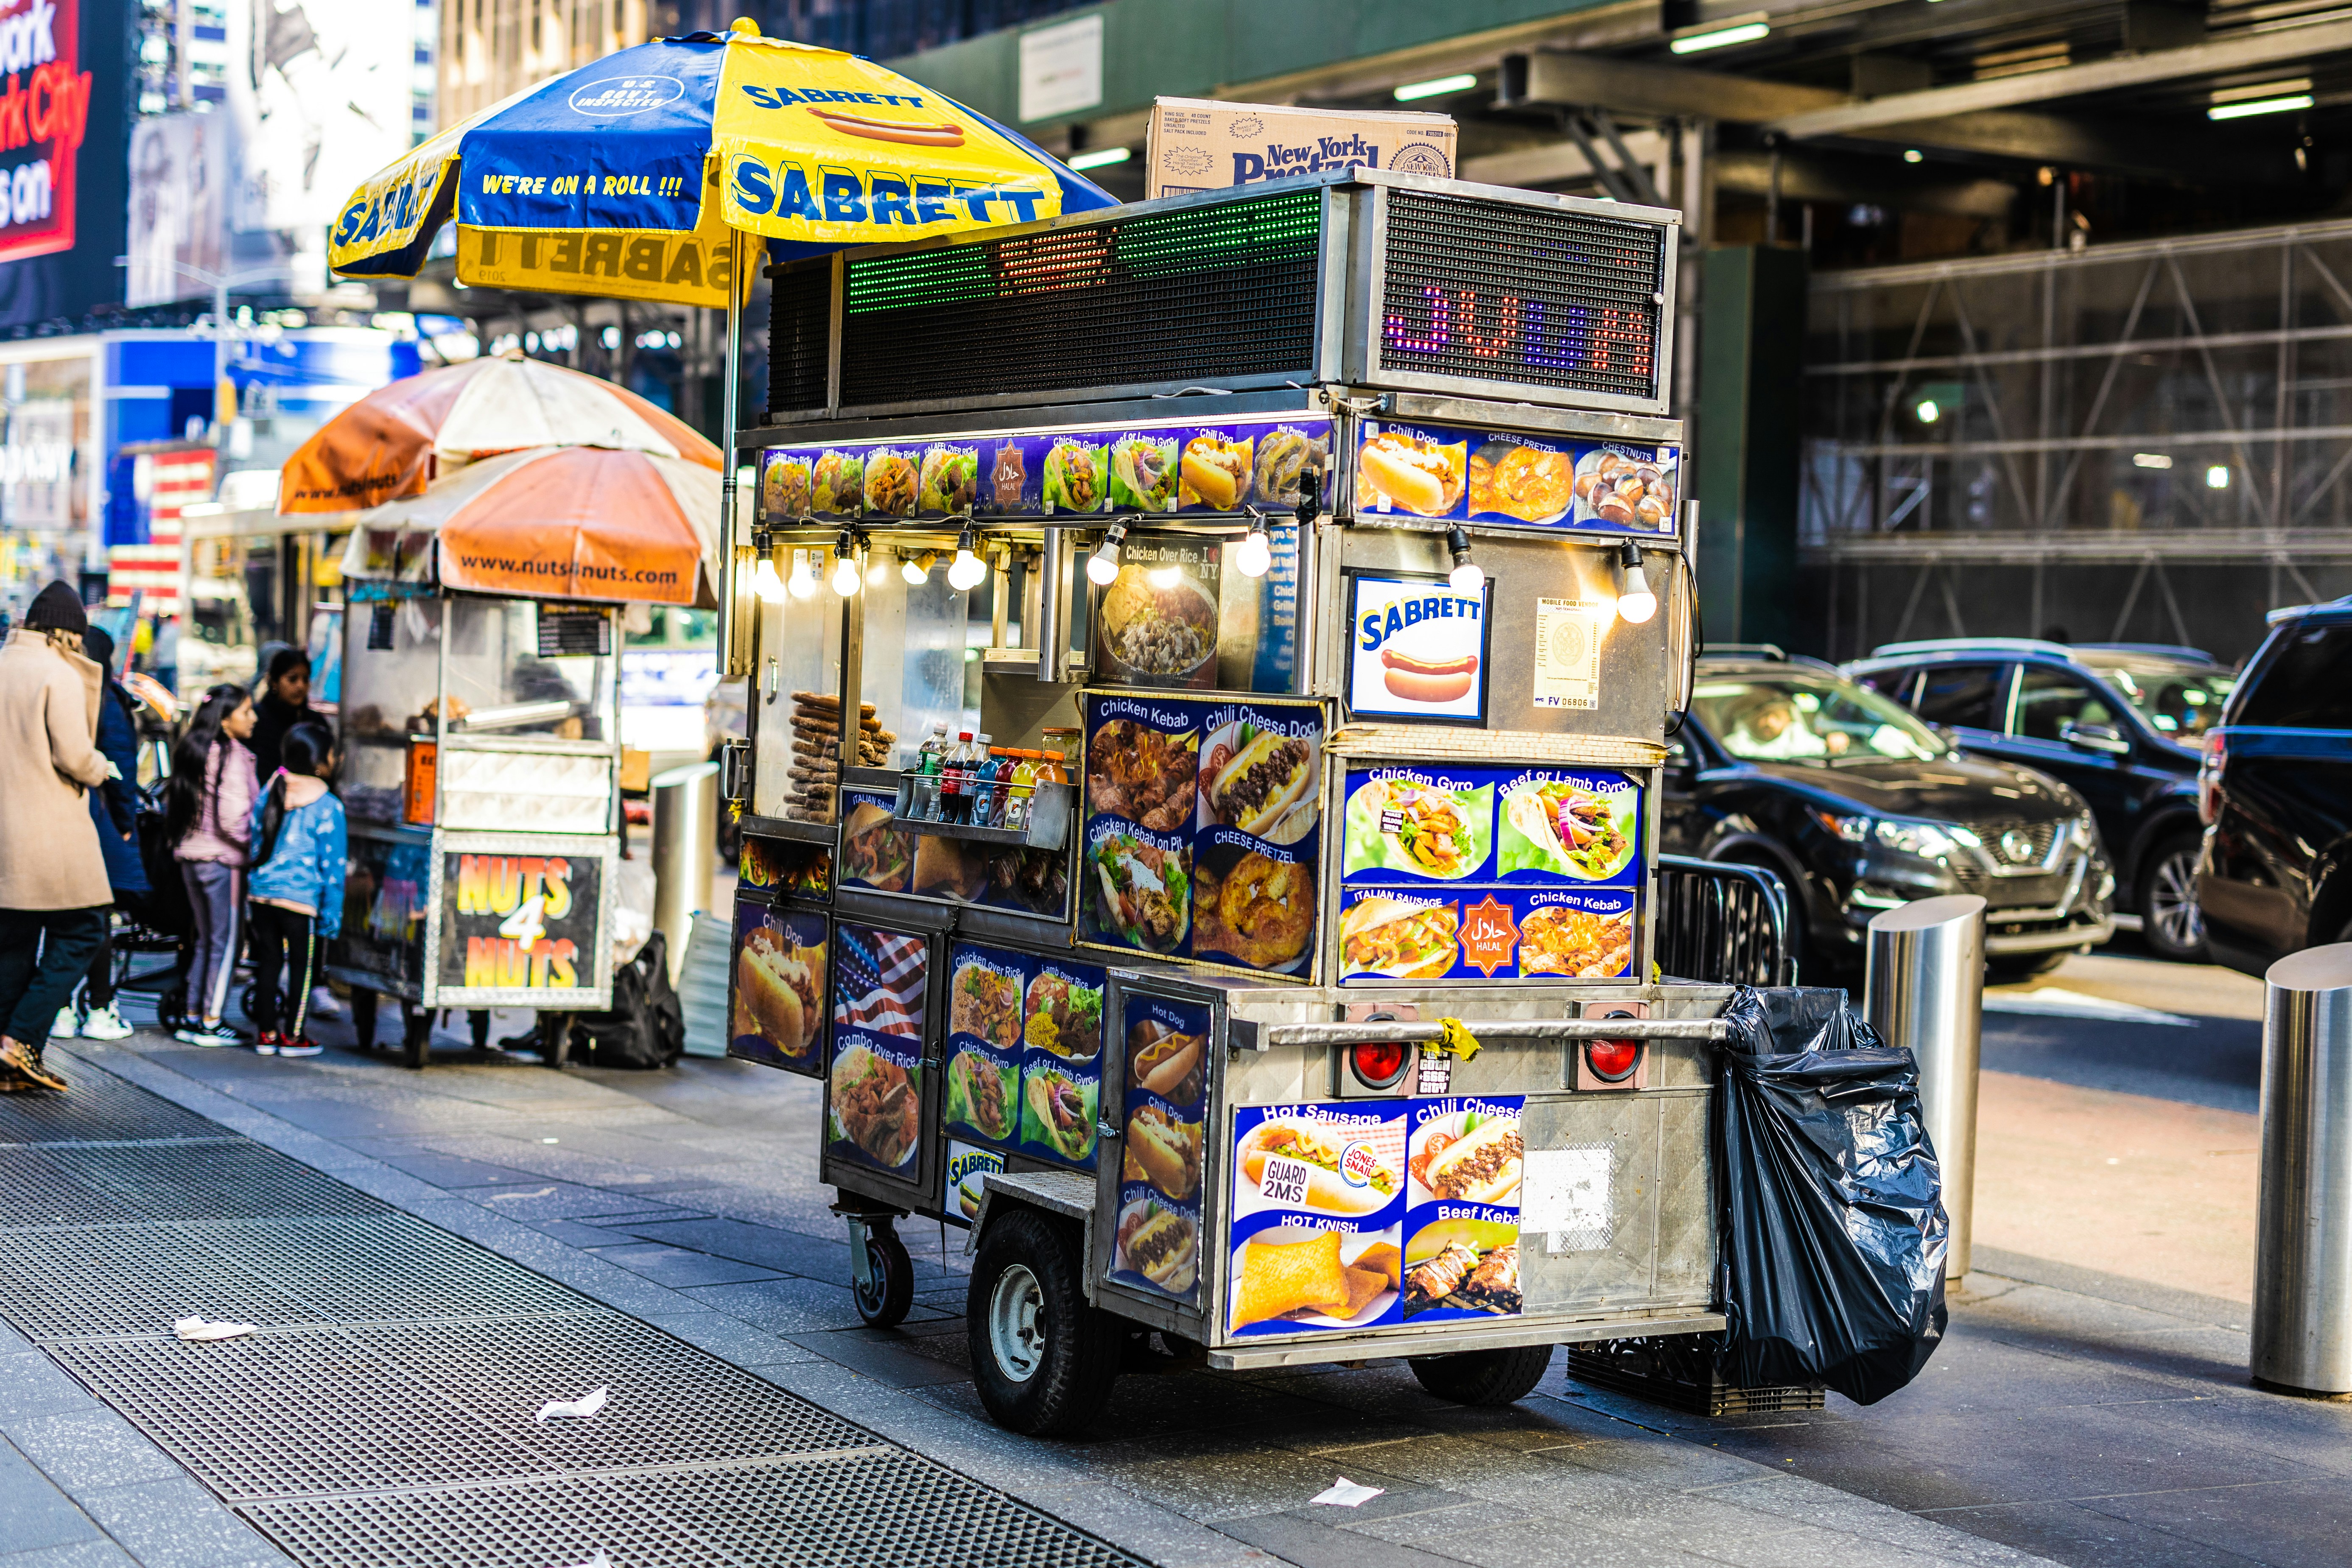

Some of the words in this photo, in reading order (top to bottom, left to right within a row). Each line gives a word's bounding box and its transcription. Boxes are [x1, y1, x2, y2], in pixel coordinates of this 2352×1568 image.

[576, 98, 663, 107] INSPECTED
[600, 89, 657, 99] GOV'T
[741, 84, 923, 109] SABRETT
[28, 61, 92, 188] City
[1266, 144, 1312, 167] New
[1317, 133, 1368, 160] York
[1422, 163, 1437, 172] YORK
[482, 174, 547, 195] WE'RE
[551, 175, 578, 196] ON
[584, 175, 596, 195] A
[603, 175, 652, 197] ROLL
[658, 176, 683, 198] !!!
[731, 154, 1045, 226] SABRETT
[333, 170, 439, 247] SABR
[1110, 433, 1128, 454] Beef
[1127, 432, 1136, 441] or
[1136, 430, 1157, 447] Lamb
[1157, 436, 1174, 448] Gyro
[1200, 428, 1216, 441] Chili
[1216, 431, 1233, 445] Dog
[1277, 424, 1287, 434] Hot
[1288, 426, 1308, 439] Pretzel
[1388, 423, 1414, 439] Chili
[1415, 428, 1438, 447] Dog
[822, 448, 834, 457] Lamb
[845, 452, 854, 461] Rice
[867, 445, 889, 461] Combo
[889, 450, 903, 458] over
[903, 449, 917, 459] Rice
[924, 442, 945, 456] FALAFEL
[945, 444, 961, 454] OVER
[961, 445, 974, 456] RICE
[1052, 435, 1082, 449] Chicken
[1082, 439, 1100, 453] Gyro
[1488, 432, 1522, 446] CHEESE
[1523, 438, 1558, 455] PRETZEL
[1602, 441, 1652, 462] CHESTNUTS
[766, 452, 787, 467] Chicken
[787, 456, 799, 466] over
[799, 455, 811, 464] Rice
[1001, 482, 1015, 491] HALAL
[1126, 544, 1158, 562] Chicken
[1159, 547, 1178, 562] Over
[1179, 548, 1198, 564] Rice
[1202, 546, 1209, 563] I
[1200, 564, 1219, 580] NY
[1358, 592, 1481, 651] SABRETT
[1549, 696, 1560, 706] FV
[1562, 698, 1588, 706] 06806
[1101, 698, 1148, 718] Chicken
[1151, 705, 1189, 728] Kebab
[1205, 704, 1235, 732] Chili
[1240, 705, 1286, 738] Cheese
[1290, 720, 1315, 739] Dog
[1369, 768, 1433, 788] Chicken
[1437, 776, 1474, 793] Gyro
[1497, 769, 1534, 798] Beef
[1536, 771, 1552, 780] or
[1555, 770, 1593, 792] Lamb
[1596, 780, 1628, 795] Gyro
[853, 794, 876, 806] ITALIAN
[1008, 799, 1023, 819] G
[1089, 817, 1126, 843] Chicken
[1128, 822, 1155, 849] Kebab
[1158, 838, 1169, 851] on
[1171, 835, 1183, 851] Pit
[1215, 830, 1252, 849] CHEESE
[1254, 841, 1295, 864] PRETZEL
[457, 854, 573, 920] NUTS
[1354, 889, 1394, 905] ITALIAN
[1396, 892, 1442, 908] SAUSAGE
[1530, 892, 1580, 906] Chicken
[1583, 897, 1622, 911] Kebab
[498, 894, 547, 952] 4
[763, 913, 783, 936] Chili
[784, 925, 803, 950] Dog
[1471, 917, 1507, 941] حلال
[1477, 942, 1502, 952] HALAL
[464, 936, 580, 988] NUTS
[955, 952, 987, 968] Chicken
[987, 961, 1004, 975] over
[1005, 965, 1021, 977] Rice
[1041, 964, 1059, 978] Lamb
[1060, 972, 1074, 983] over
[1074, 976, 1088, 989] Rice
[1152, 1003, 1167, 1018] Hot
[1168, 1009, 1185, 1029] Dog
[837, 1032, 872, 1051] Combo
[874, 1043, 895, 1061] over
[896, 1052, 916, 1068] Rice
[959, 1041, 990, 1059] Chicken
[991, 1053, 1010, 1069] Gyro
[1022, 1057, 1040, 1078] Beef
[1042, 1059, 1051, 1068] or
[1052, 1060, 1074, 1080] Lamb
[1074, 1072, 1093, 1086] Gyro
[1419, 1059, 1451, 1071] GOTH
[1423, 1070, 1446, 1082] 666
[1420, 1082, 1447, 1093] CITY
[1148, 1096, 1166, 1114] Chili
[1167, 1104, 1183, 1124] Dog
[1262, 1106, 1300, 1122] Hot
[1304, 1104, 1382, 1126] Sausage
[1416, 1098, 1457, 1125] Chili
[1463, 1097, 1524, 1119] Cheese
[949, 1151, 1003, 1187] SABRETT
[1345, 1158, 1370, 1178] SNAIL
[1348, 1149, 1376, 1168] JONES
[1267, 1160, 1307, 1185] GUARD
[1263, 1181, 1303, 1203] 2MS
[1123, 1188, 1146, 1204] Chili
[1147, 1188, 1178, 1217] Cheese
[1179, 1207, 1196, 1220] Dog
[1438, 1205, 1478, 1221] Beef
[1481, 1208, 1519, 1225] Keba
[1281, 1214, 1313, 1229] HOT
[1315, 1219, 1359, 1234] KNISH
